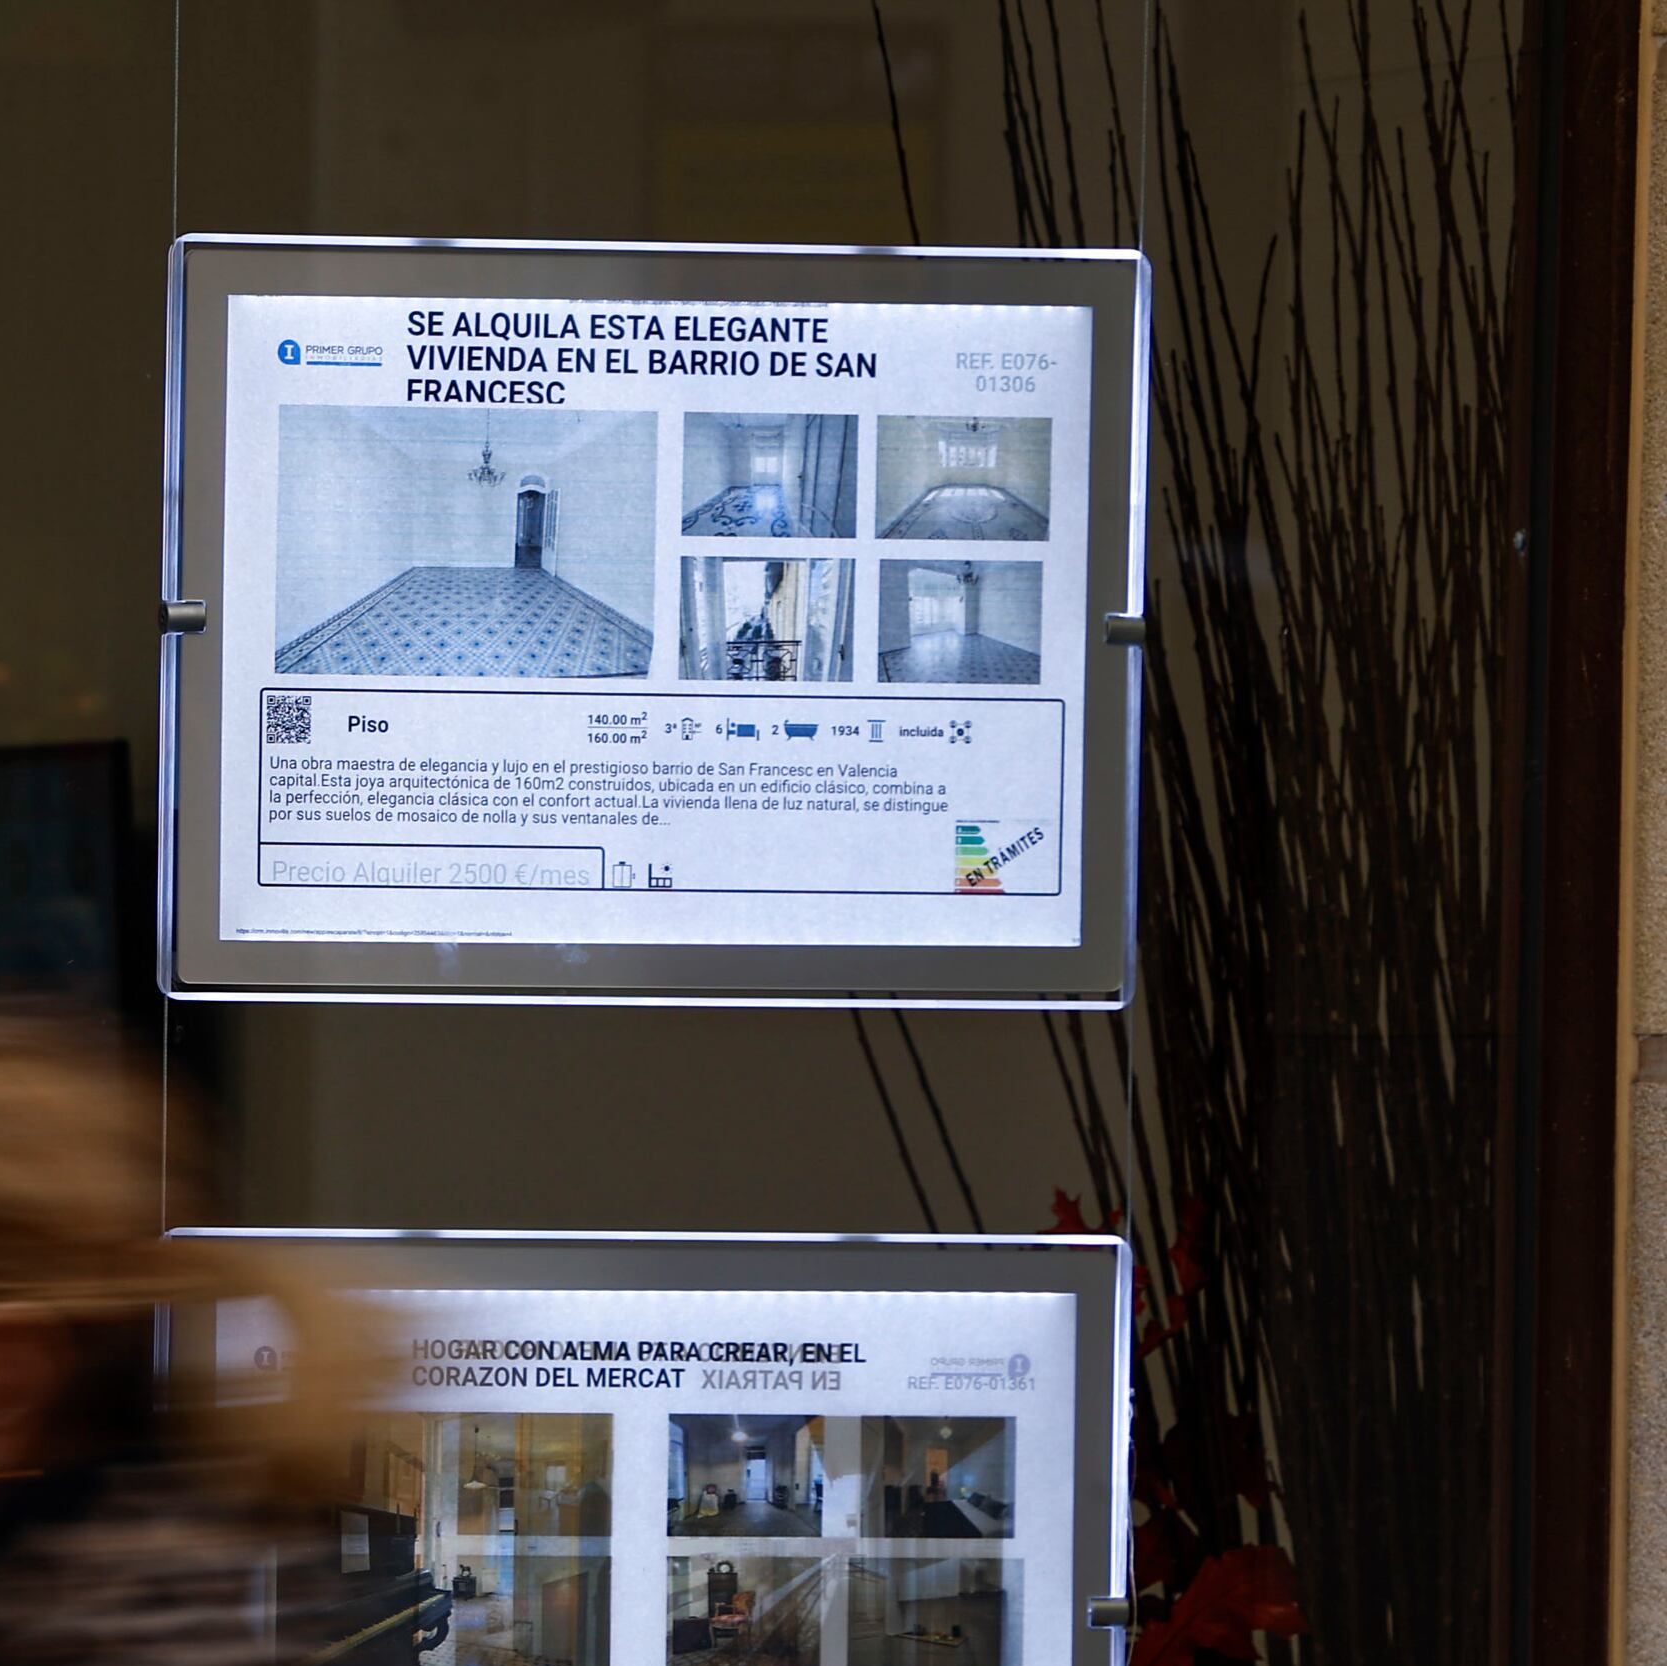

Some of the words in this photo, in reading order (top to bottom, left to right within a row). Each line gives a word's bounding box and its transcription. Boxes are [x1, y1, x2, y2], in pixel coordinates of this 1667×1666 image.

[407, 310, 444, 337] SE
[452, 311, 581, 342] ALQUILA
[590, 314, 665, 341] ESTA
[674, 315, 829, 344] ELEGANTE
[406, 344, 548, 373] VIVIENDA
[557, 347, 596, 373] EN
[605, 348, 639, 374] EL
[648, 349, 760, 377] BARRIO
[769, 351, 807, 377] DE
[815, 351, 877, 378] SAN
[956, 352, 996, 370] REF.
[1001, 353, 1058, 371] E076-
[407, 378, 566, 405] FRANCESC
[975, 375, 1036, 393] 01306
[348, 715, 389, 733] Piso
[831, 725, 860, 736] 1934
[272, 861, 345, 883] Precio
[354, 862, 441, 885] Alquiler
[449, 864, 506, 885] 2500
[515, 864, 590, 887] €/mes
[412, 1339, 496, 1361] HOGAR
[504, 1340, 557, 1361] CON
[562, 1341, 630, 1362] ALMA
[637, 1341, 701, 1362] PARA
[707, 1342, 795, 1367] CREAR,
[802, 1342, 836, 1363] EN
[840, 1342, 866, 1363] EL
[411, 1366, 528, 1388] CORAZON
[535, 1367, 580, 1388] DEL
[586, 1367, 686, 1388] MERCAT
